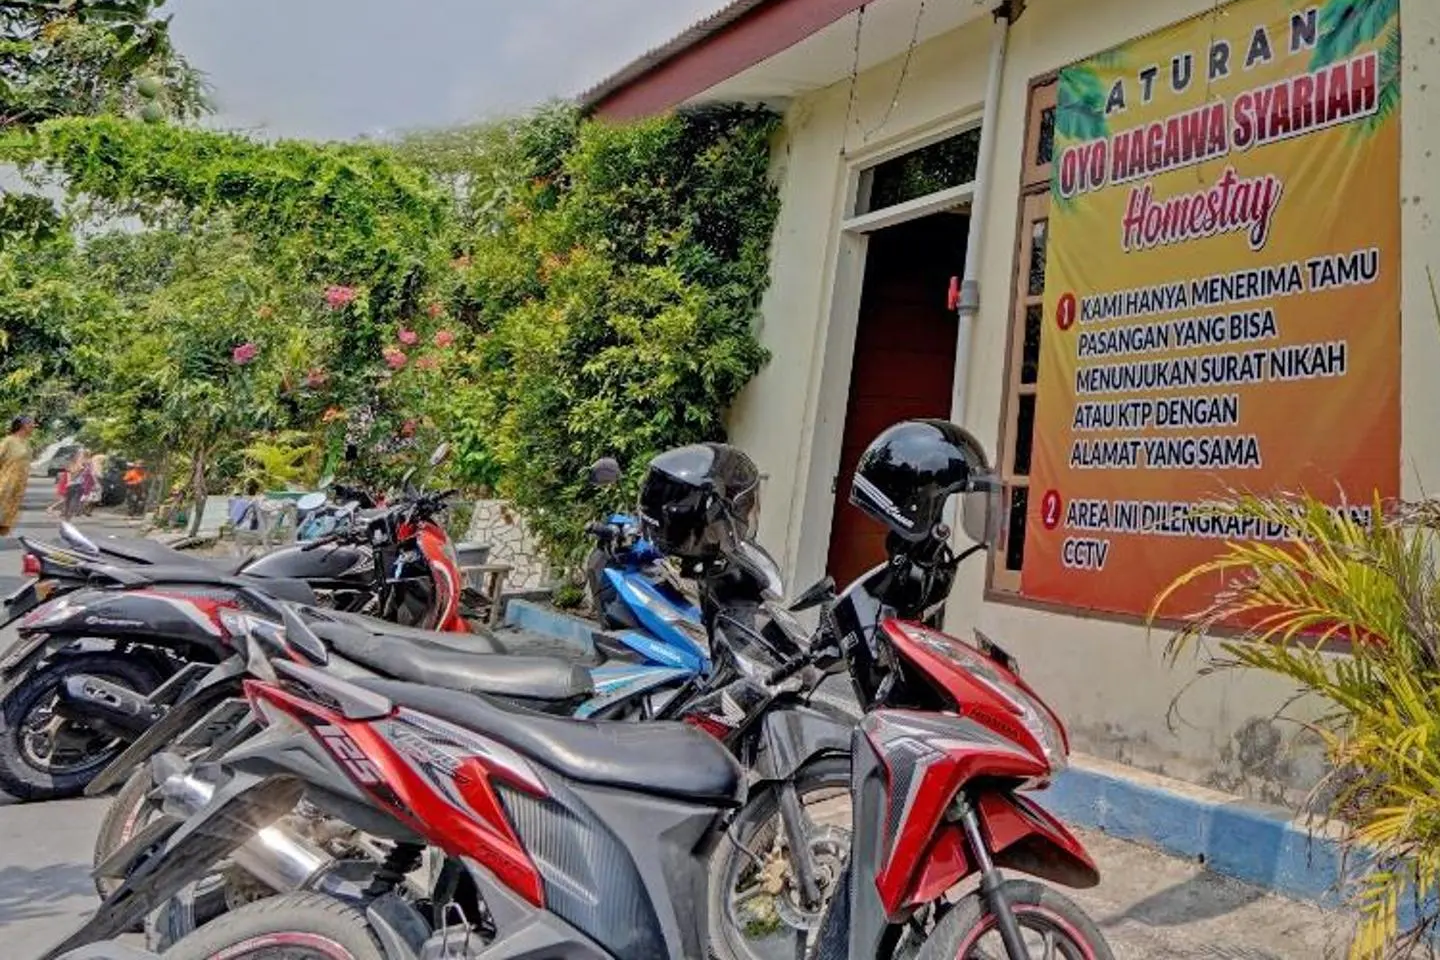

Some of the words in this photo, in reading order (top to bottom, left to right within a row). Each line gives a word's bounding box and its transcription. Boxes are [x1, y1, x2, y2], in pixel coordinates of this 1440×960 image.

[1106, 9, 1318, 113] ATURAN
[1060, 145, 1108, 197] OYO
[1111, 108, 1228, 182] HAGAWA
[1233, 54, 1378, 146] SYARIAH
[1122, 168, 1279, 250] Homestay
[1081, 294, 1123, 322] KAMI
[1126, 287, 1189, 316] HANYA
[1191, 267, 1302, 306] MENERIMA
[1308, 251, 1378, 288] TAMU
[1078, 325, 1169, 356] PASANGAN
[1173, 318, 1227, 346] YANG
[1230, 311, 1276, 340] BISA
[1076, 359, 1198, 392] MENUNJUKAN
[1200, 353, 1267, 382] SURAT
[1270, 344, 1346, 377] NIKAH
[1073, 404, 1118, 429] ATAU
[1118, 403, 1152, 427] KTP
[1155, 397, 1238, 425] DENGAN
[1070, 440, 1142, 467] ALAMAT
[1143, 440, 1200, 466] YANG
[1199, 437, 1260, 466] SAMA
[1066, 501, 1109, 529] AREA
[1114, 503, 1139, 529] INI
[1063, 542, 1108, 567] CCTV
[313, 723, 387, 784] 125
